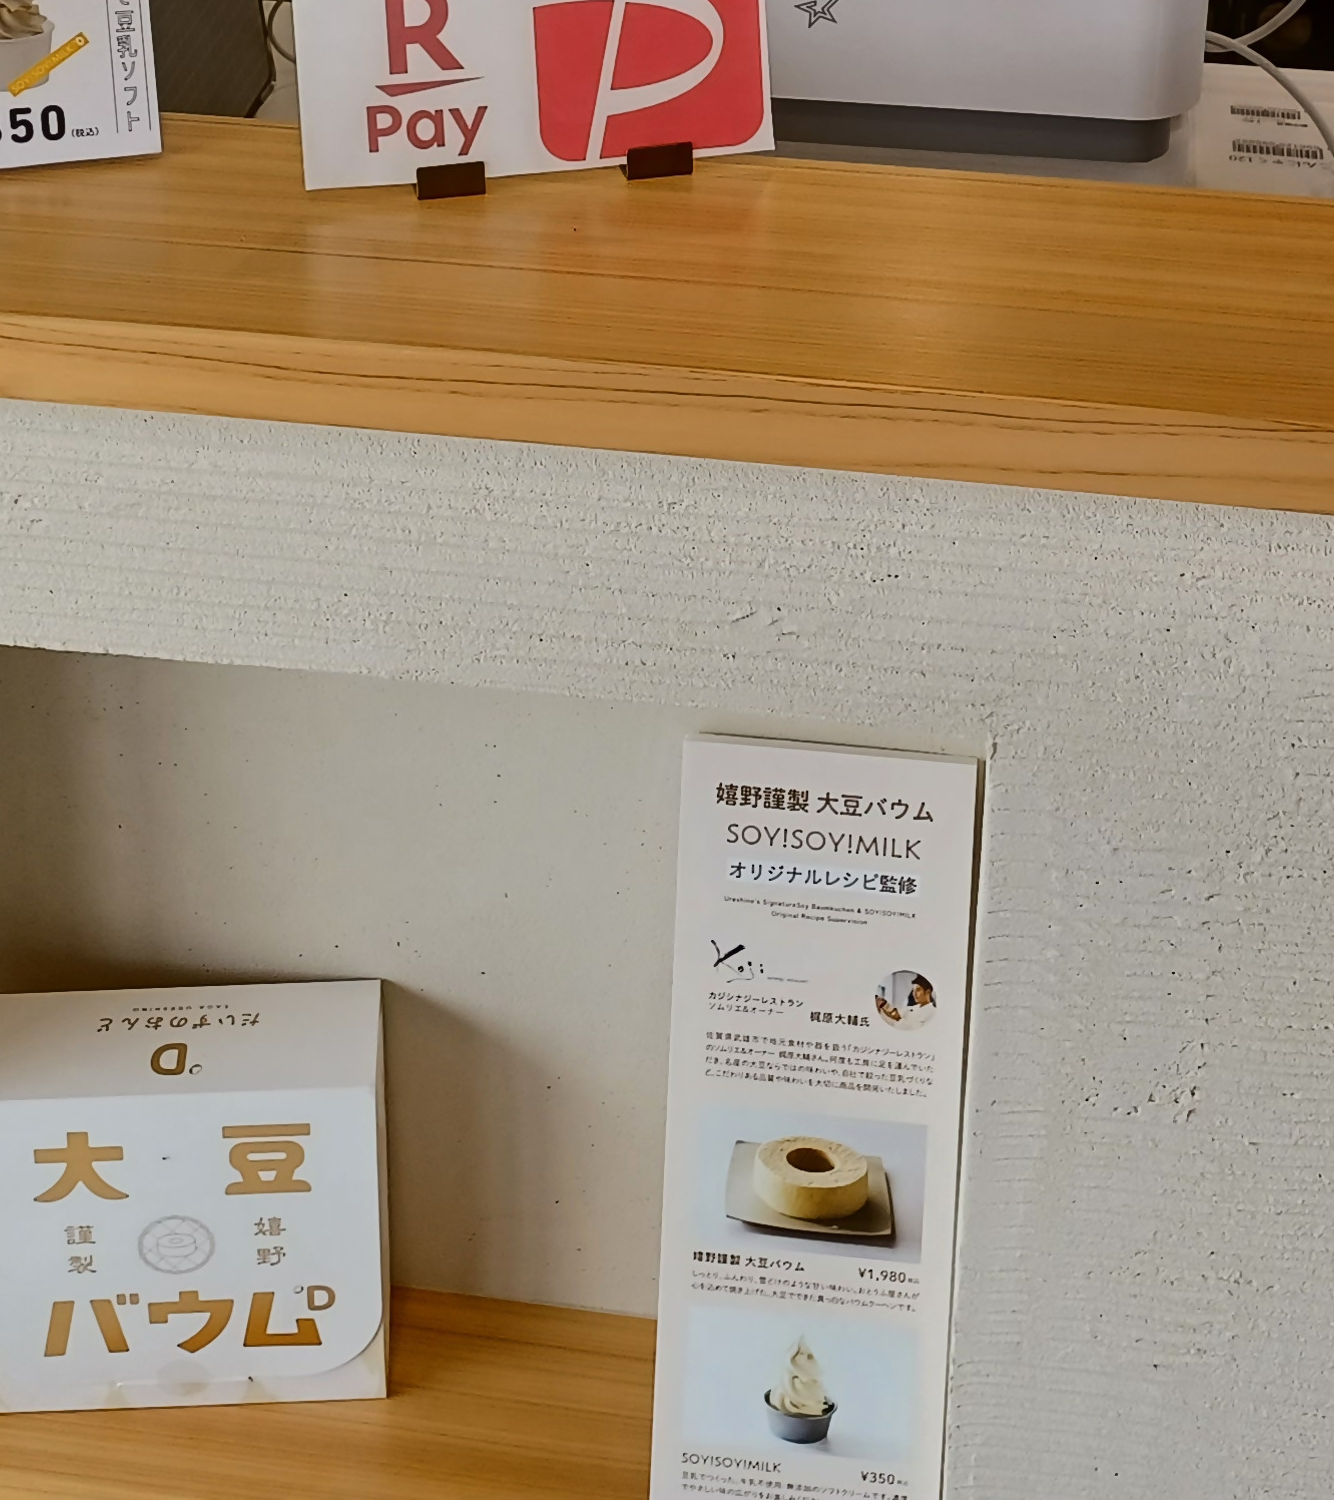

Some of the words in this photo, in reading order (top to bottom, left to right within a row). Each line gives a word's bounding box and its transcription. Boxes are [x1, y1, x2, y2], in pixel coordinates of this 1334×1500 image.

[366, 105, 488, 156] Pay
[716, 782, 809, 813] 嬉野謹製
[817, 792, 933, 822] 大豆バウム
[726, 824, 921, 860] SOY!SOY!MILK
[729, 862, 917, 895] オリジナルレシピ監修
[44, 1290, 322, 1357] バウム
[861, 1471, 895, 1485] ¥350
